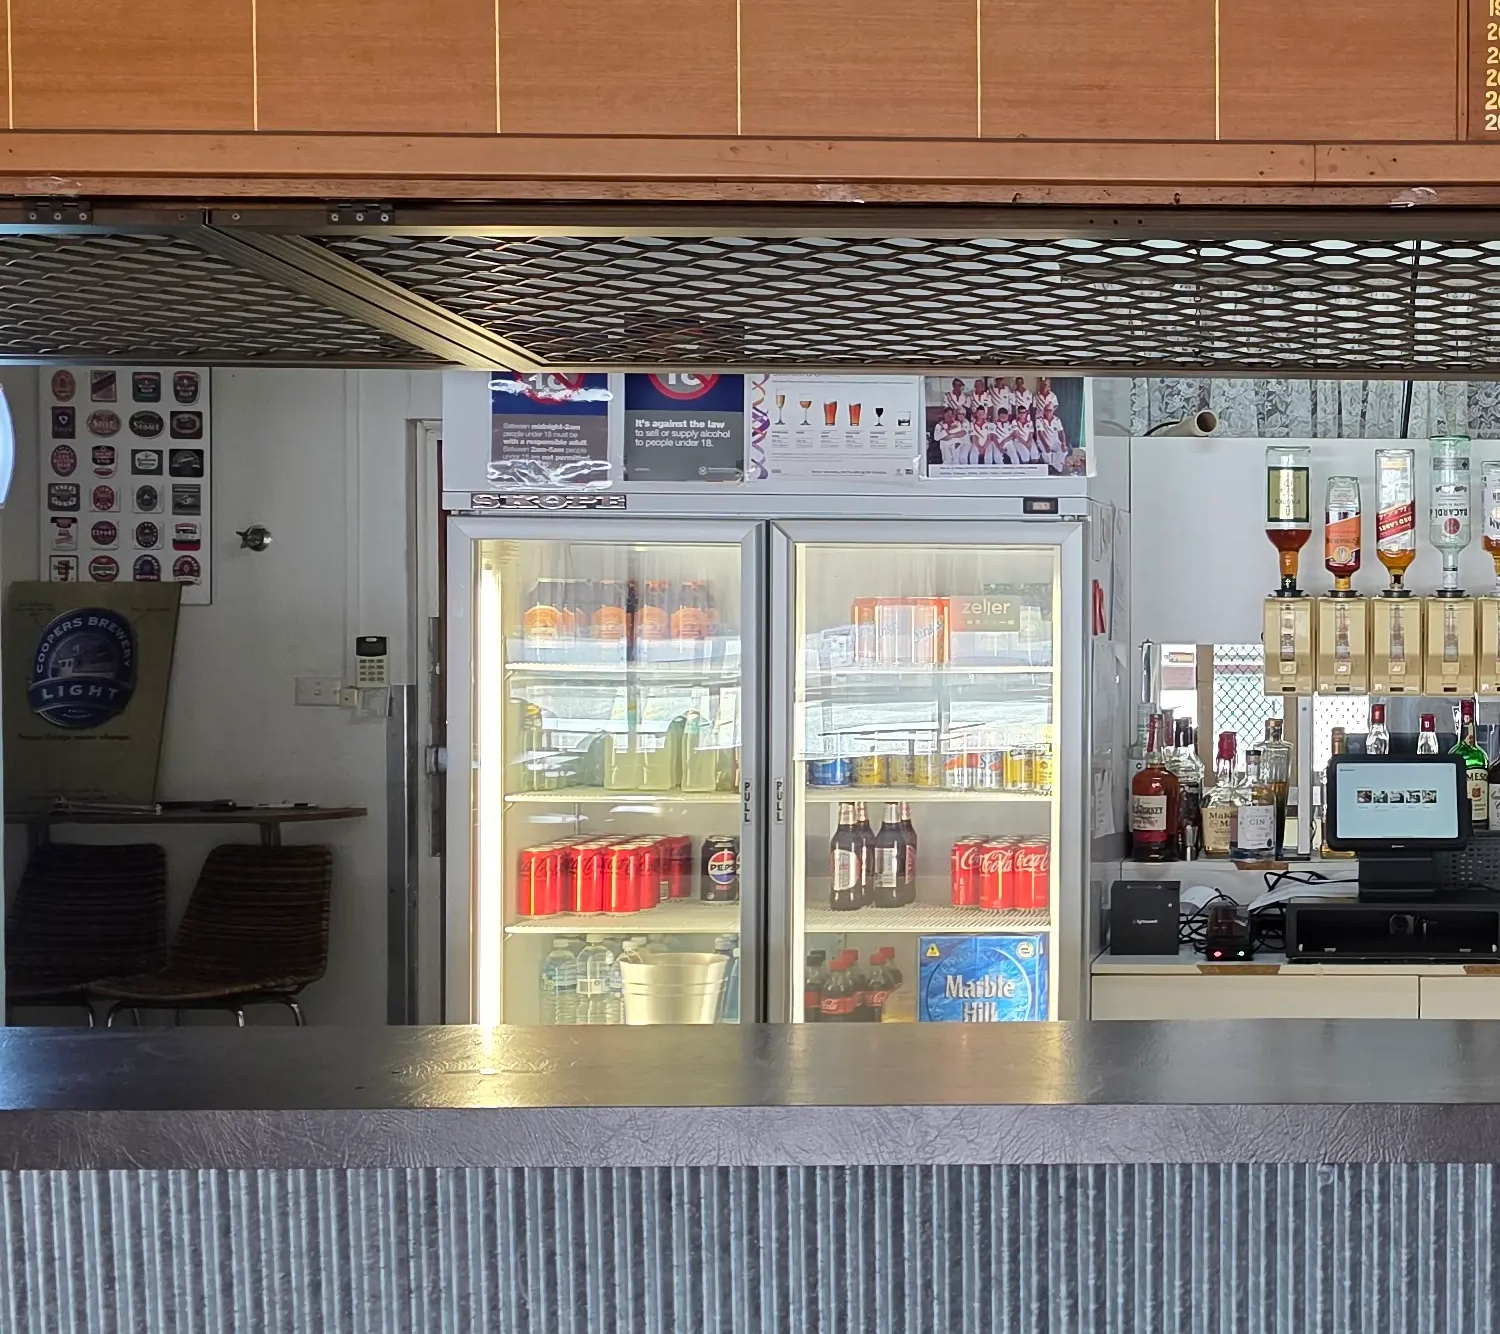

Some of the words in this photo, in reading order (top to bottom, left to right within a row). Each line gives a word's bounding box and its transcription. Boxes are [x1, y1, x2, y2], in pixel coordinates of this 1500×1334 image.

[635, 418, 651, 428] It's
[652, 419, 688, 431] against
[689, 419, 706, 429] the
[635, 429, 644, 438] to
[660, 430, 671, 438] or
[671, 429, 699, 440] supply
[700, 429, 731, 439] alcohol
[635, 439, 644, 447] to
[645, 440, 673, 449] people
[674, 438, 700, 447] under
[471, 493, 627, 510] SKOPE
[36, 617, 83, 674] COOPERS
[87, 616, 133, 668] BREWERY
[41, 684, 121, 701] LIGHT
[743, 781, 751, 823] PULL
[775, 780, 783, 822] PULL
[1248, 818, 1266, 826] GIN
[945, 974, 1016, 999] Marble
